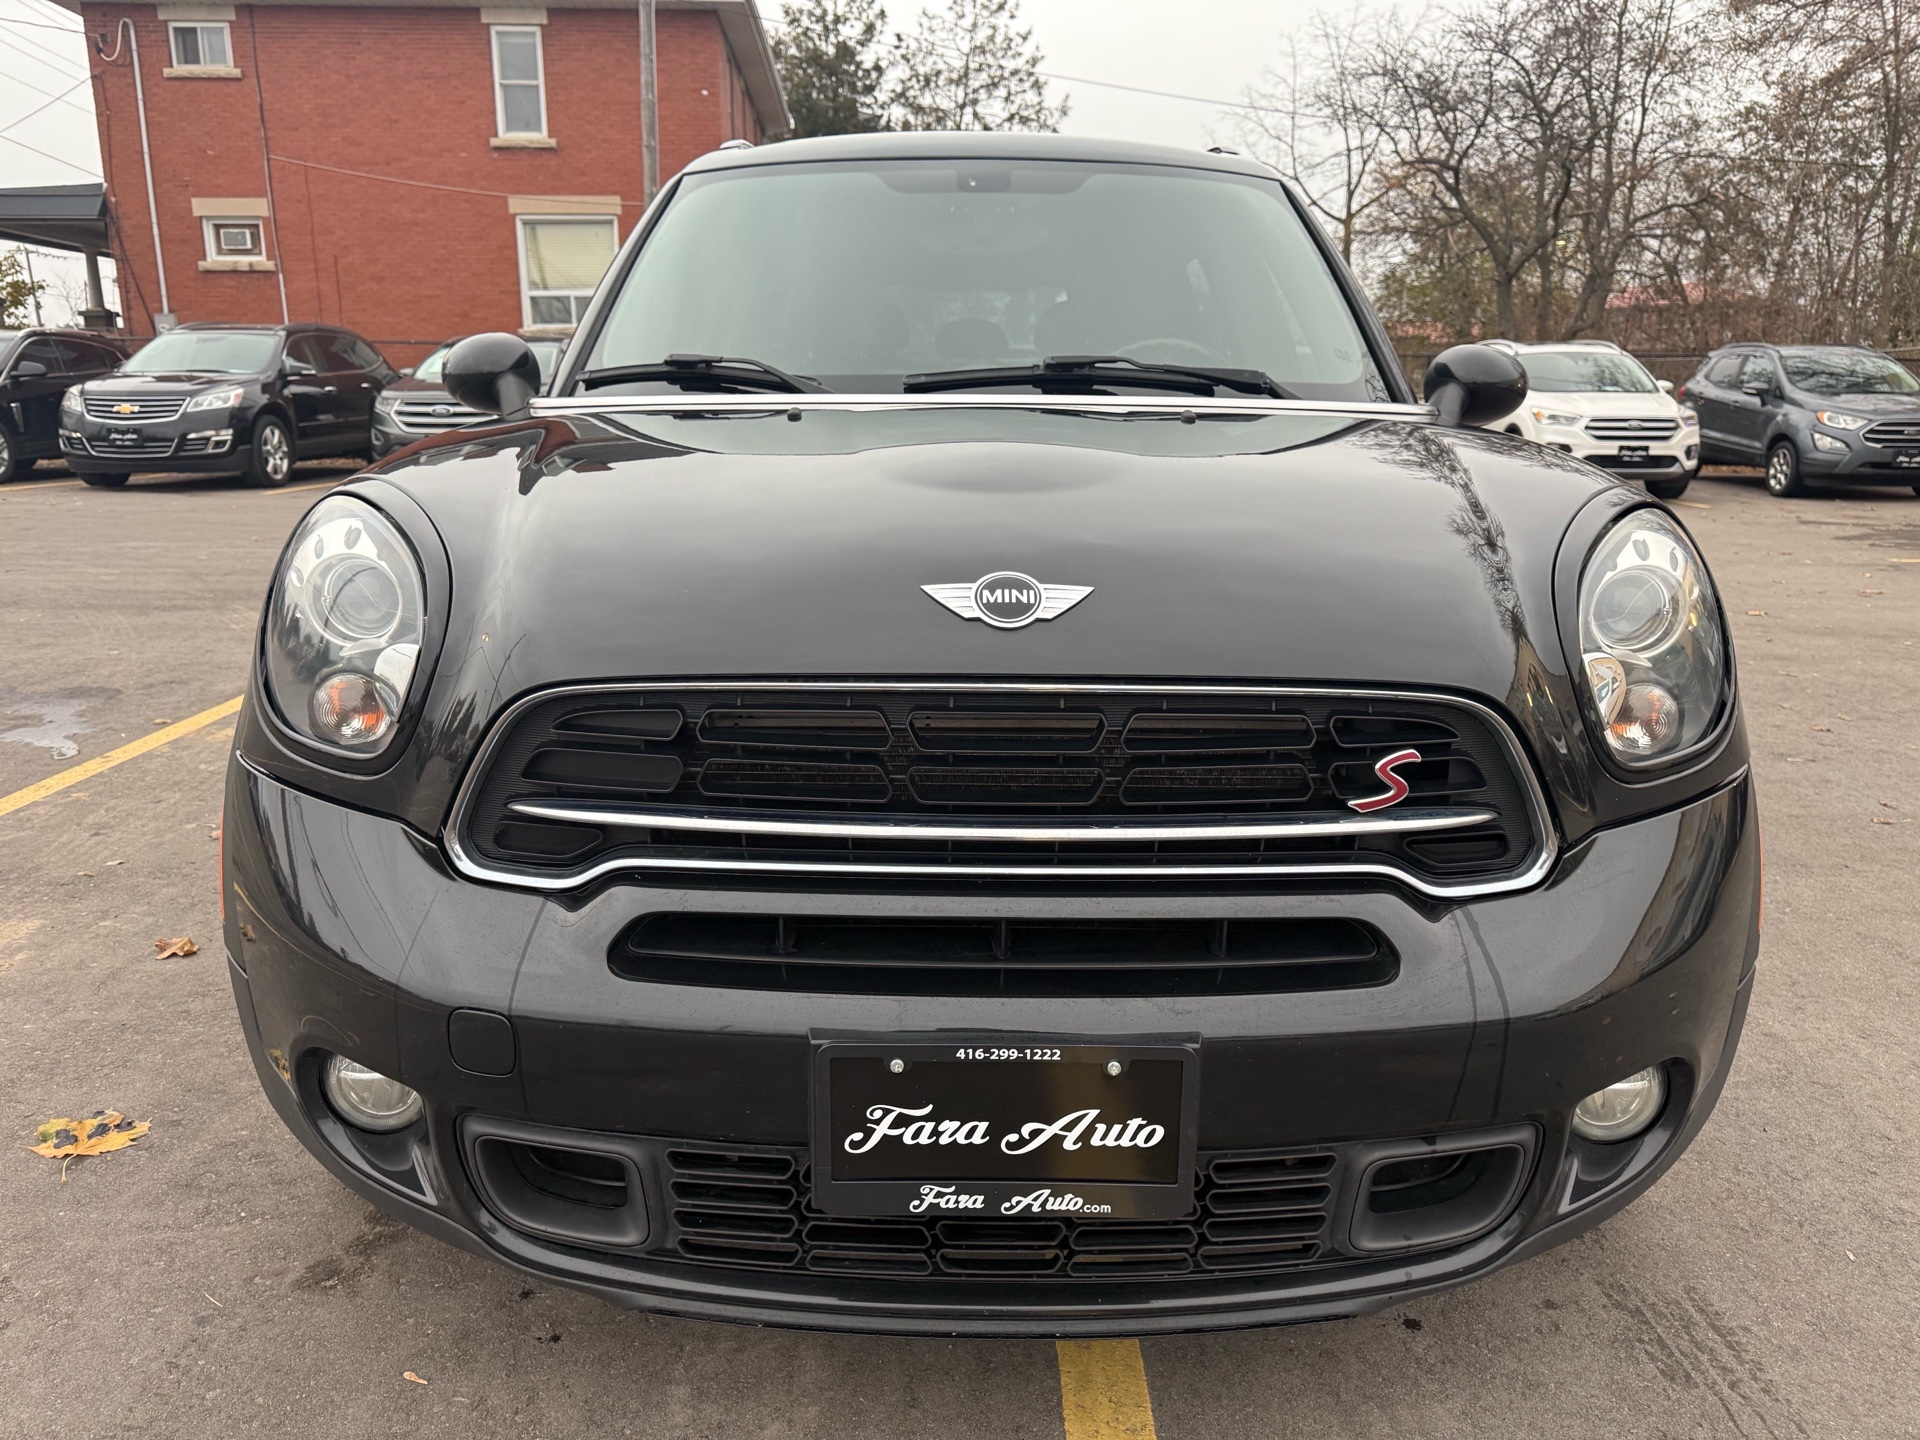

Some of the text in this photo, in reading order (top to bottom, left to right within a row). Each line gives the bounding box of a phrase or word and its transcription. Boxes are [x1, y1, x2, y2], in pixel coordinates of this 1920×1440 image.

[982, 588, 1036, 604] MINI
[1347, 748, 1422, 813] S
[955, 1048, 1061, 1061] 416-299-1222
[843, 1103, 1165, 1155] Fara Auto
[909, 1184, 1112, 1215] Fara Auto.com
